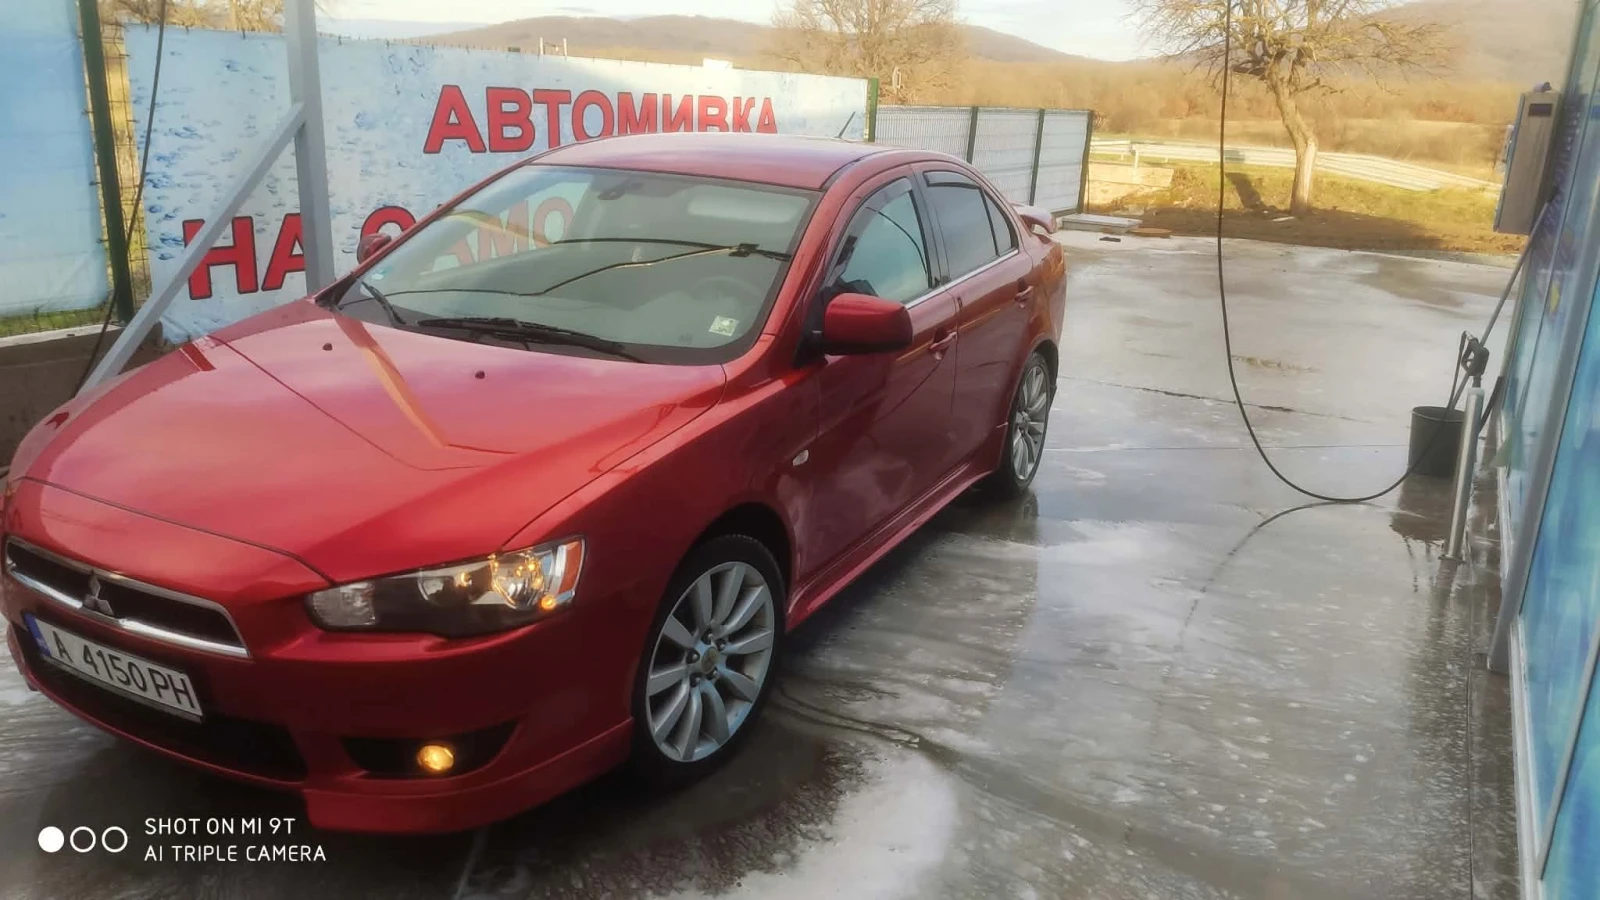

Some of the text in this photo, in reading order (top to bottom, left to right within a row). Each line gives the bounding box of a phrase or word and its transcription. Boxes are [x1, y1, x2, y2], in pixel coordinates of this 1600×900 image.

[423, 84, 778, 153] АВТОМИВКА
[52, 630, 195, 709] A 4150 PH
